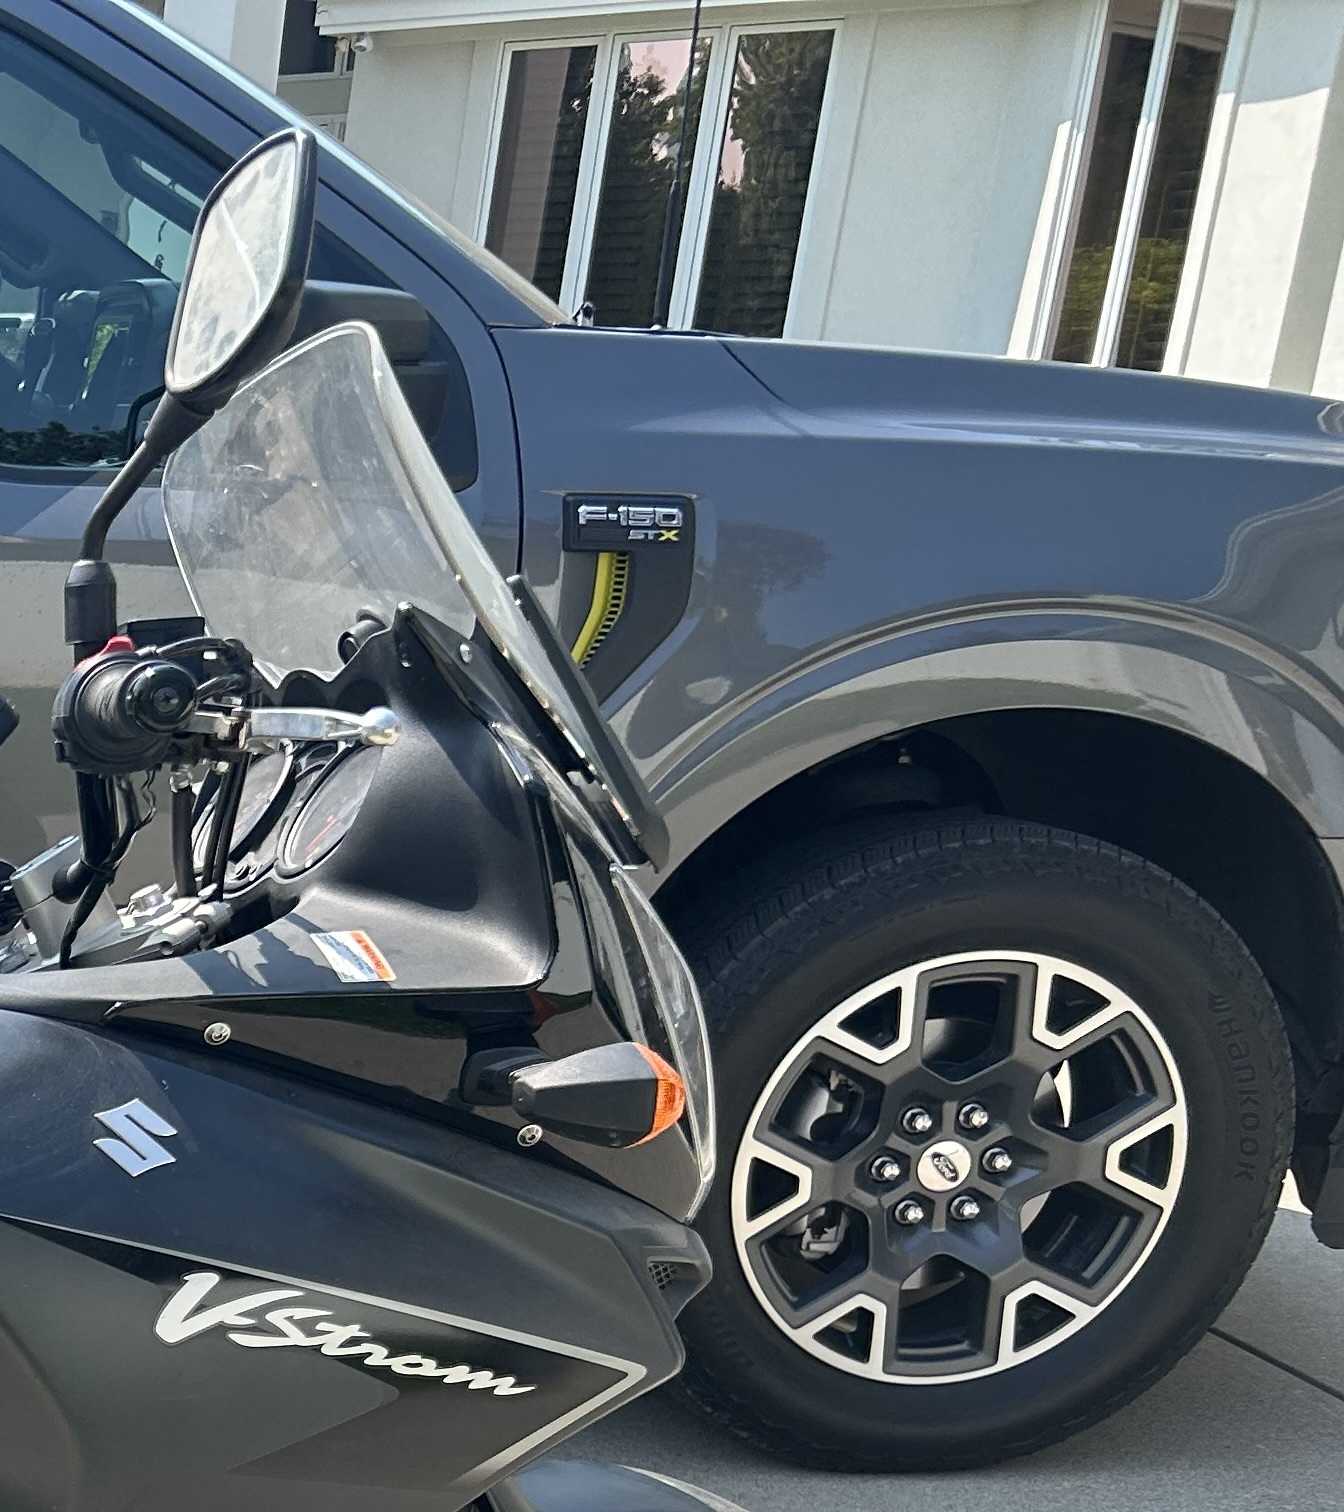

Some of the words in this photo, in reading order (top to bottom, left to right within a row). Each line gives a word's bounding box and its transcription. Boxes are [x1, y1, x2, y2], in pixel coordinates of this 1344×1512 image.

[577, 504, 683, 527] F-150
[628, 529, 680, 542] STX
[933, 1157, 956, 1180] Ford
